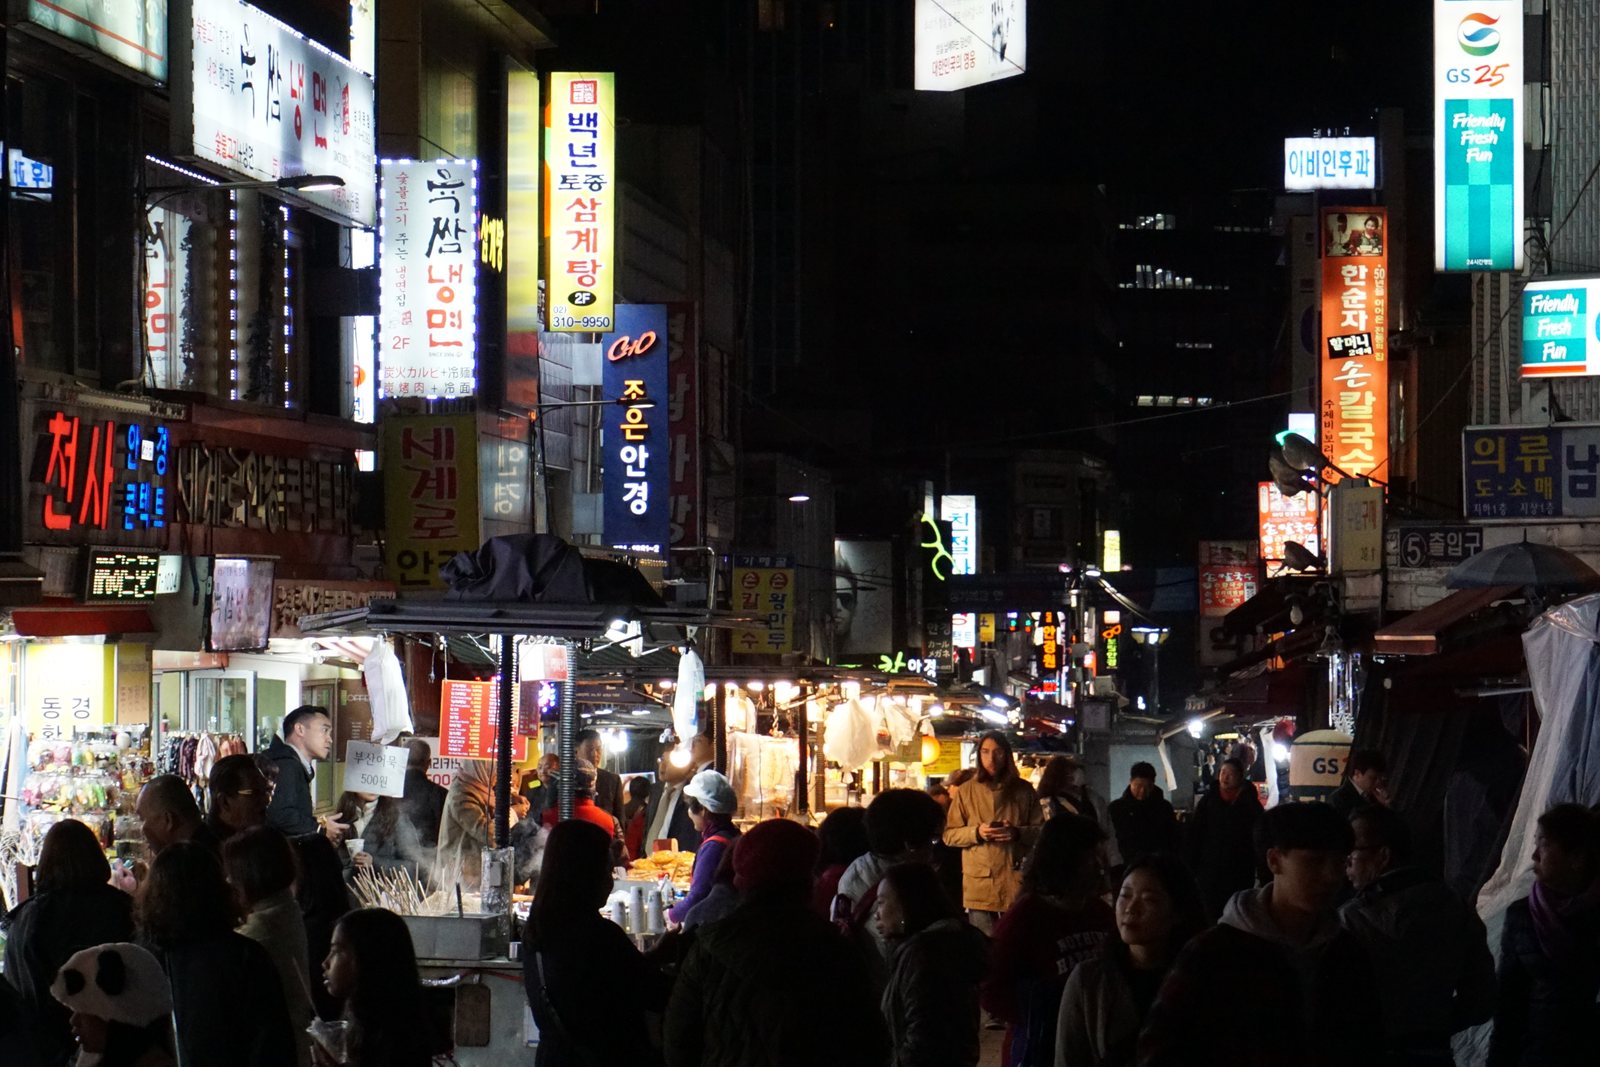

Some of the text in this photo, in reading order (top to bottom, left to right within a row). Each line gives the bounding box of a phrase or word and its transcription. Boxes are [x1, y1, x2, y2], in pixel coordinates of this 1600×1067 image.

[1452, 112, 1506, 132] Friendly
[568, 111, 599, 168] 백년
[1460, 130, 1498, 146] Fresh
[1289, 149, 1371, 178] 이비인후과
[1466, 147, 1493, 164] Fun
[558, 173, 608, 192] 토종
[394, 171, 409, 227] 숯불고기
[394, 232, 409, 260] 주는
[565, 197, 602, 288] 삼계탕
[574, 292, 591, 304] 2F
[1341, 264, 1369, 332] 한순자
[1530, 293, 1580, 318] Friendly
[553, 316, 610, 328] 310-9950
[1537, 317, 1573, 338] Fresh
[392, 335, 411, 350] 2F
[607, 331, 657, 361] CHO
[1329, 333, 1370, 351] 할머니
[1542, 341, 1568, 362] Fun
[1333, 360, 1377, 477] 손칼국수
[127, 423, 168, 475] 안경
[1471, 435, 1553, 474] 의류
[44, 411, 115, 530] 천사
[401, 427, 461, 539] 세계로
[124, 481, 166, 531] 콘택트
[1407, 537, 1421, 565] 5
[1429, 532, 1481, 557] 출입구
[397, 550, 453, 586] 안
[41, 697, 91, 719] 동경
[352, 751, 398, 768] 부산어묵
[1312, 757, 1339, 774] GS
[361, 773, 388, 788] 500원
